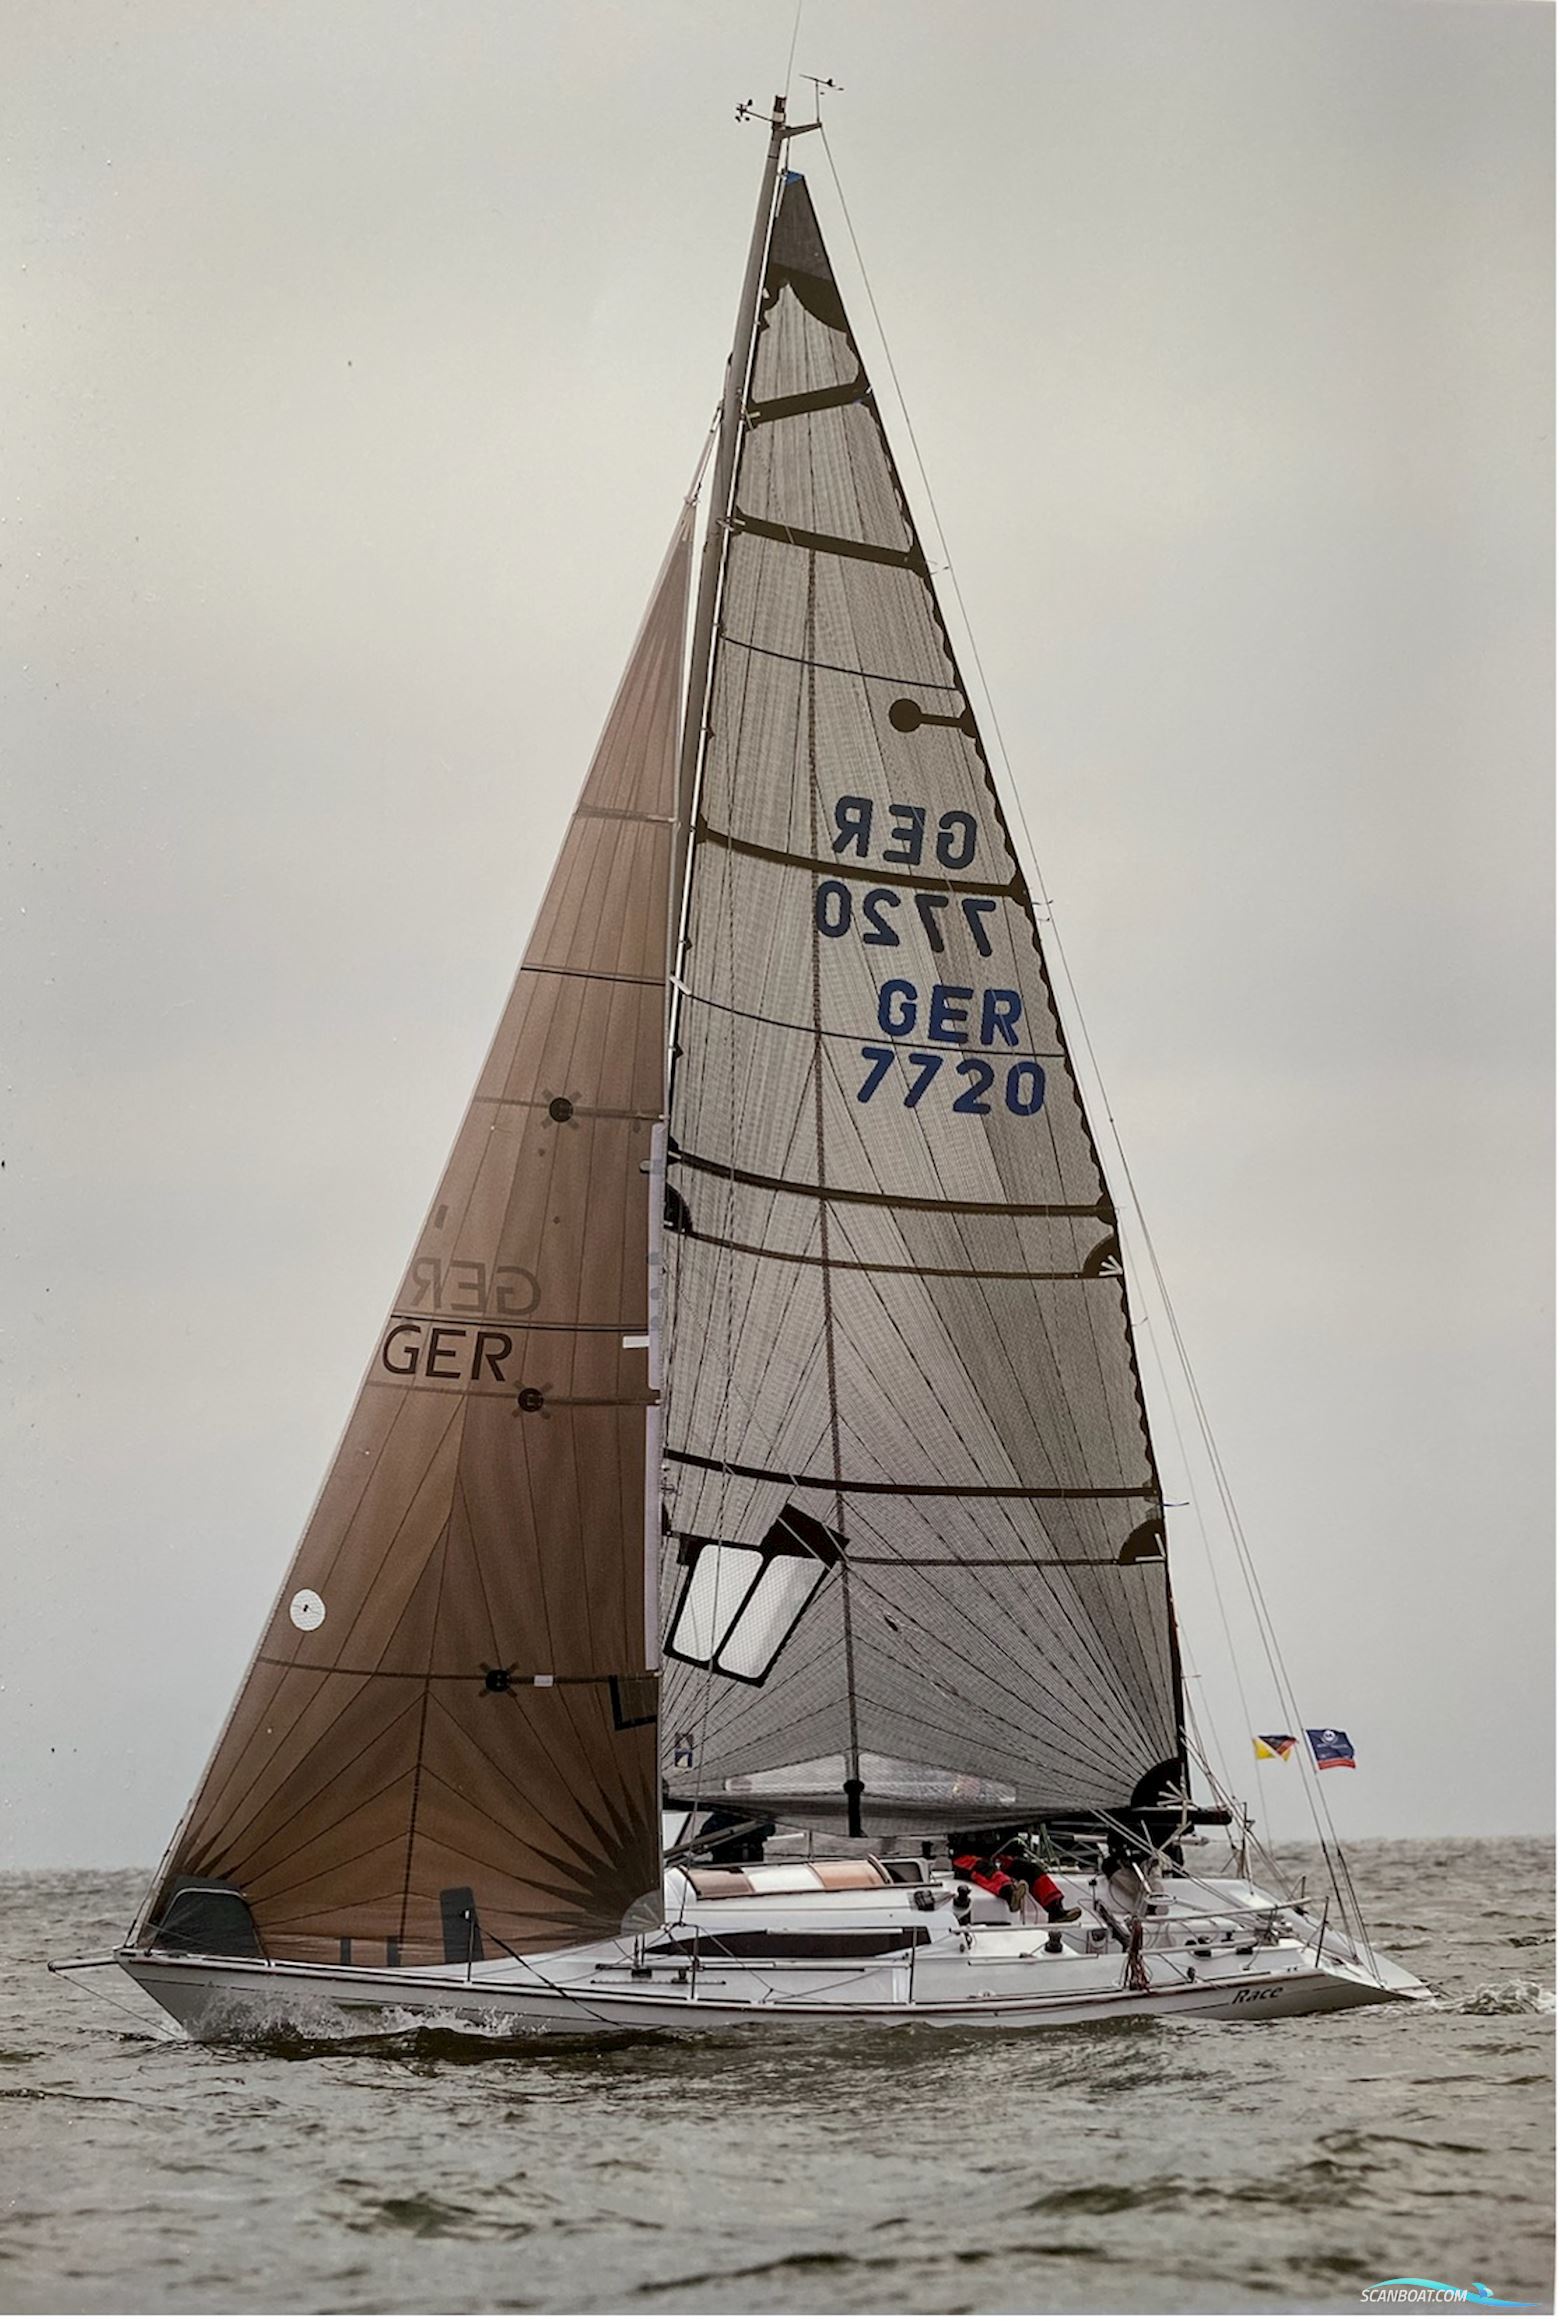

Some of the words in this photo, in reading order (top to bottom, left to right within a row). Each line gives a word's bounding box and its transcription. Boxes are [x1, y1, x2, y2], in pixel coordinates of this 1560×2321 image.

[877, 979, 1022, 1047] GER
[856, 1046, 1046, 1117] 7720
[382, 1323, 513, 1383] GER
